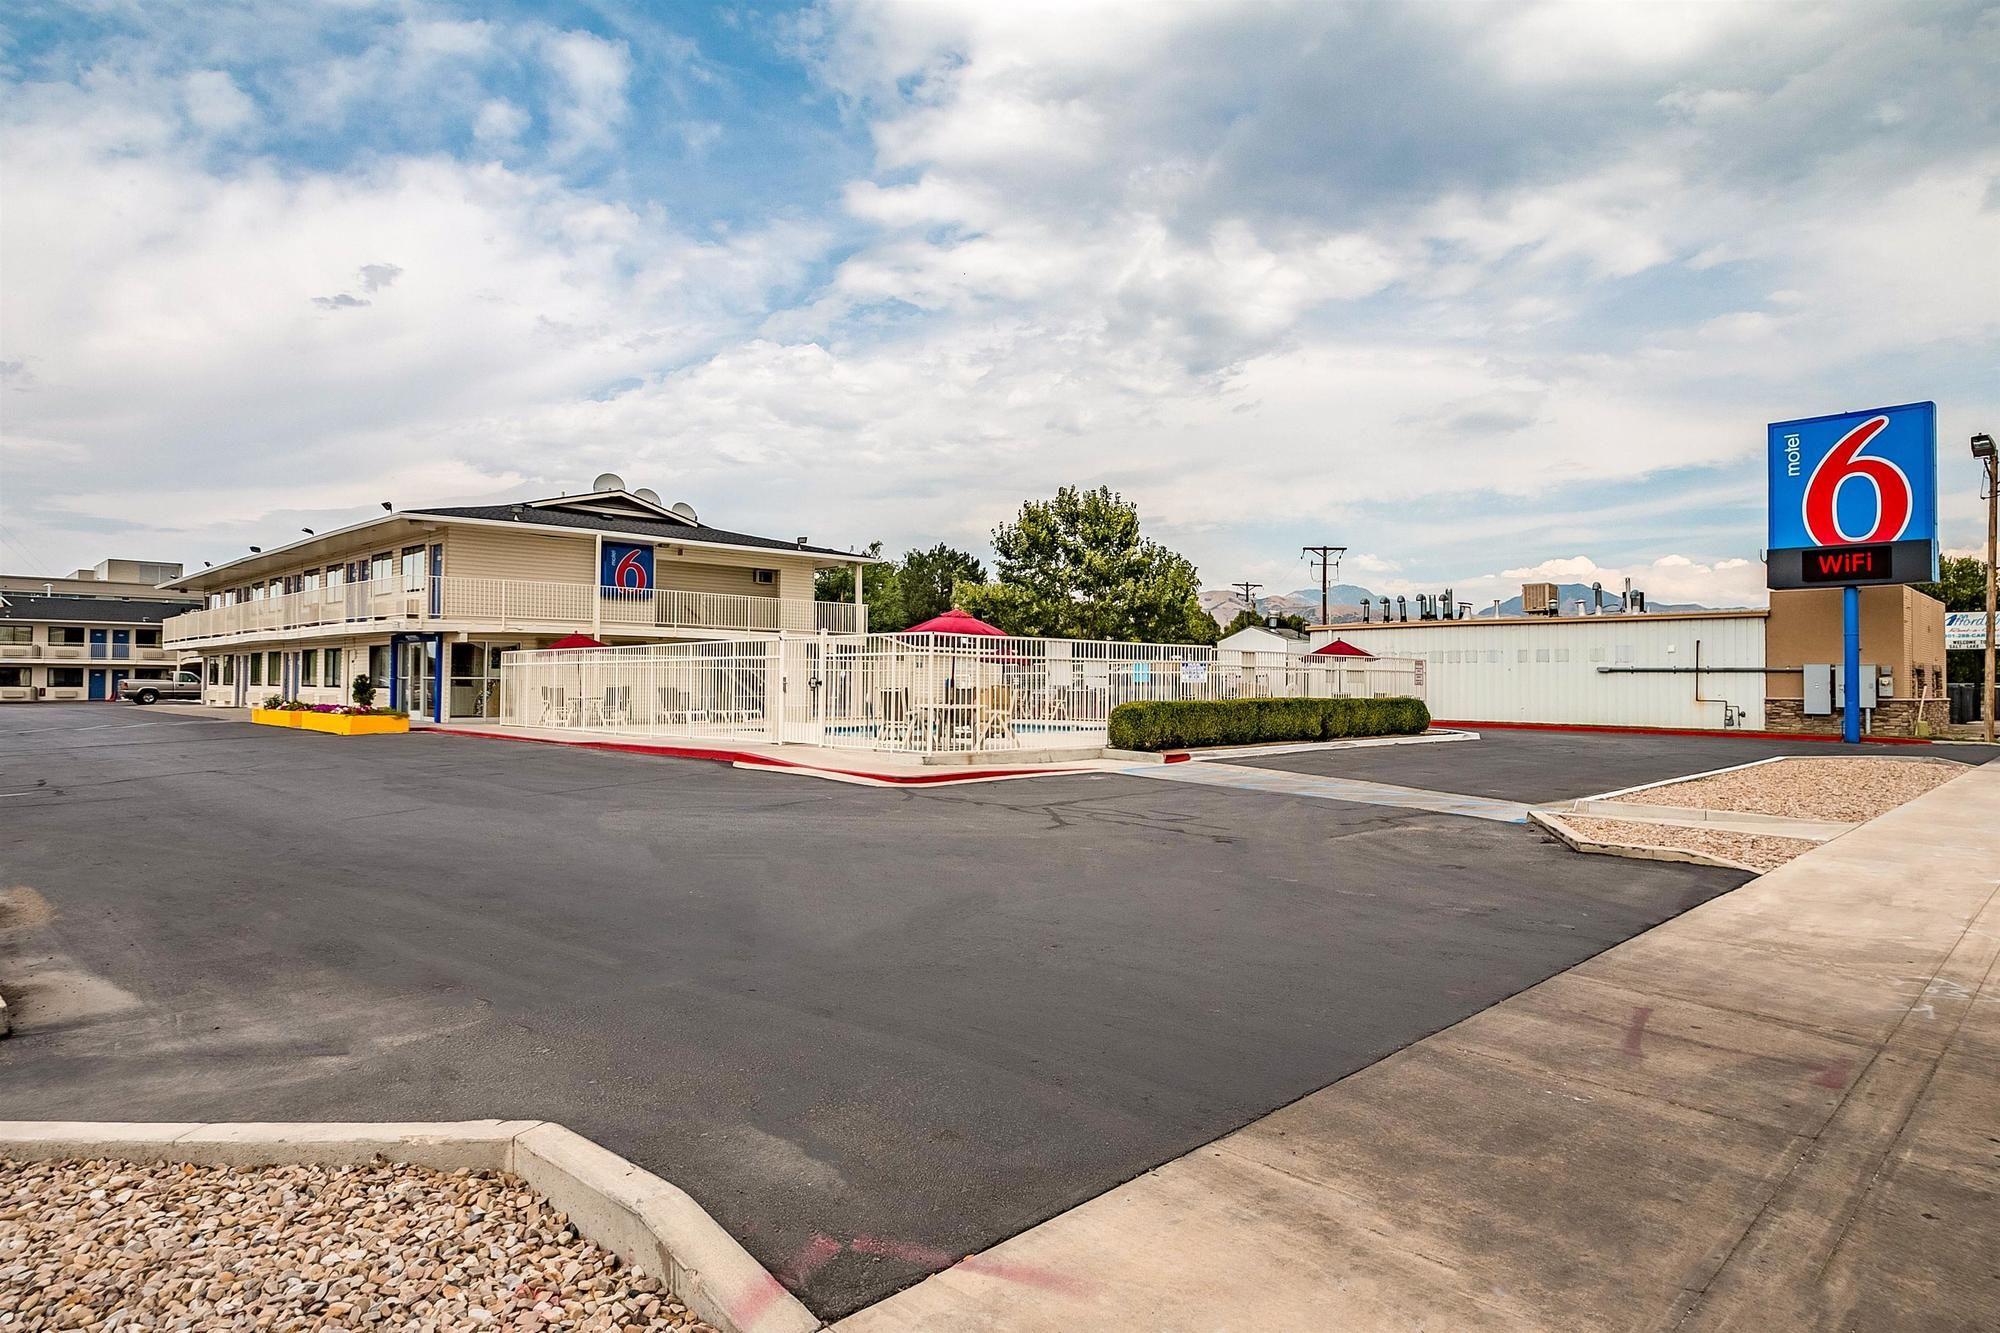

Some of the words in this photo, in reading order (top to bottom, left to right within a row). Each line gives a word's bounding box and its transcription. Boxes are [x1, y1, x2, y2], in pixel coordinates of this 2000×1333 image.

[1784, 433, 1801, 477] motel
[1802, 415, 1913, 547] 6
[615, 549, 647, 595] 6
[1819, 552, 1873, 575] WiFi
